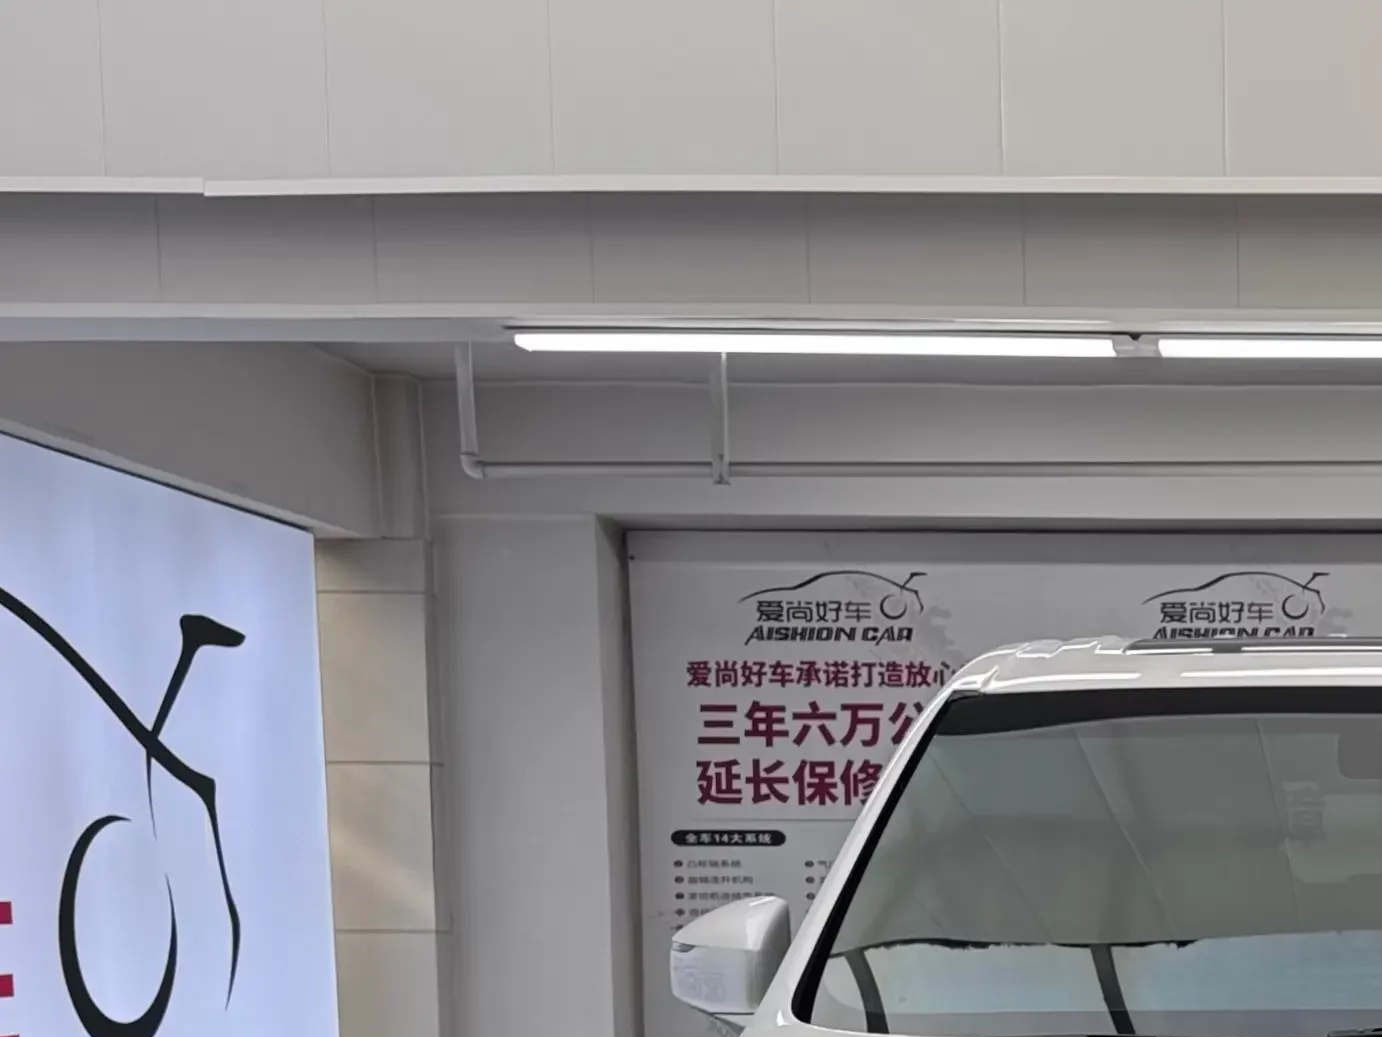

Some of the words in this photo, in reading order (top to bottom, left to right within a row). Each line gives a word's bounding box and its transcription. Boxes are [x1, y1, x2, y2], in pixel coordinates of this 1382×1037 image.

[756, 600, 872, 622] 爱尚好车
[1159, 600, 1273, 623] 爱尚好车
[744, 625, 856, 646] AISHION
[861, 625, 913, 646] CAR
